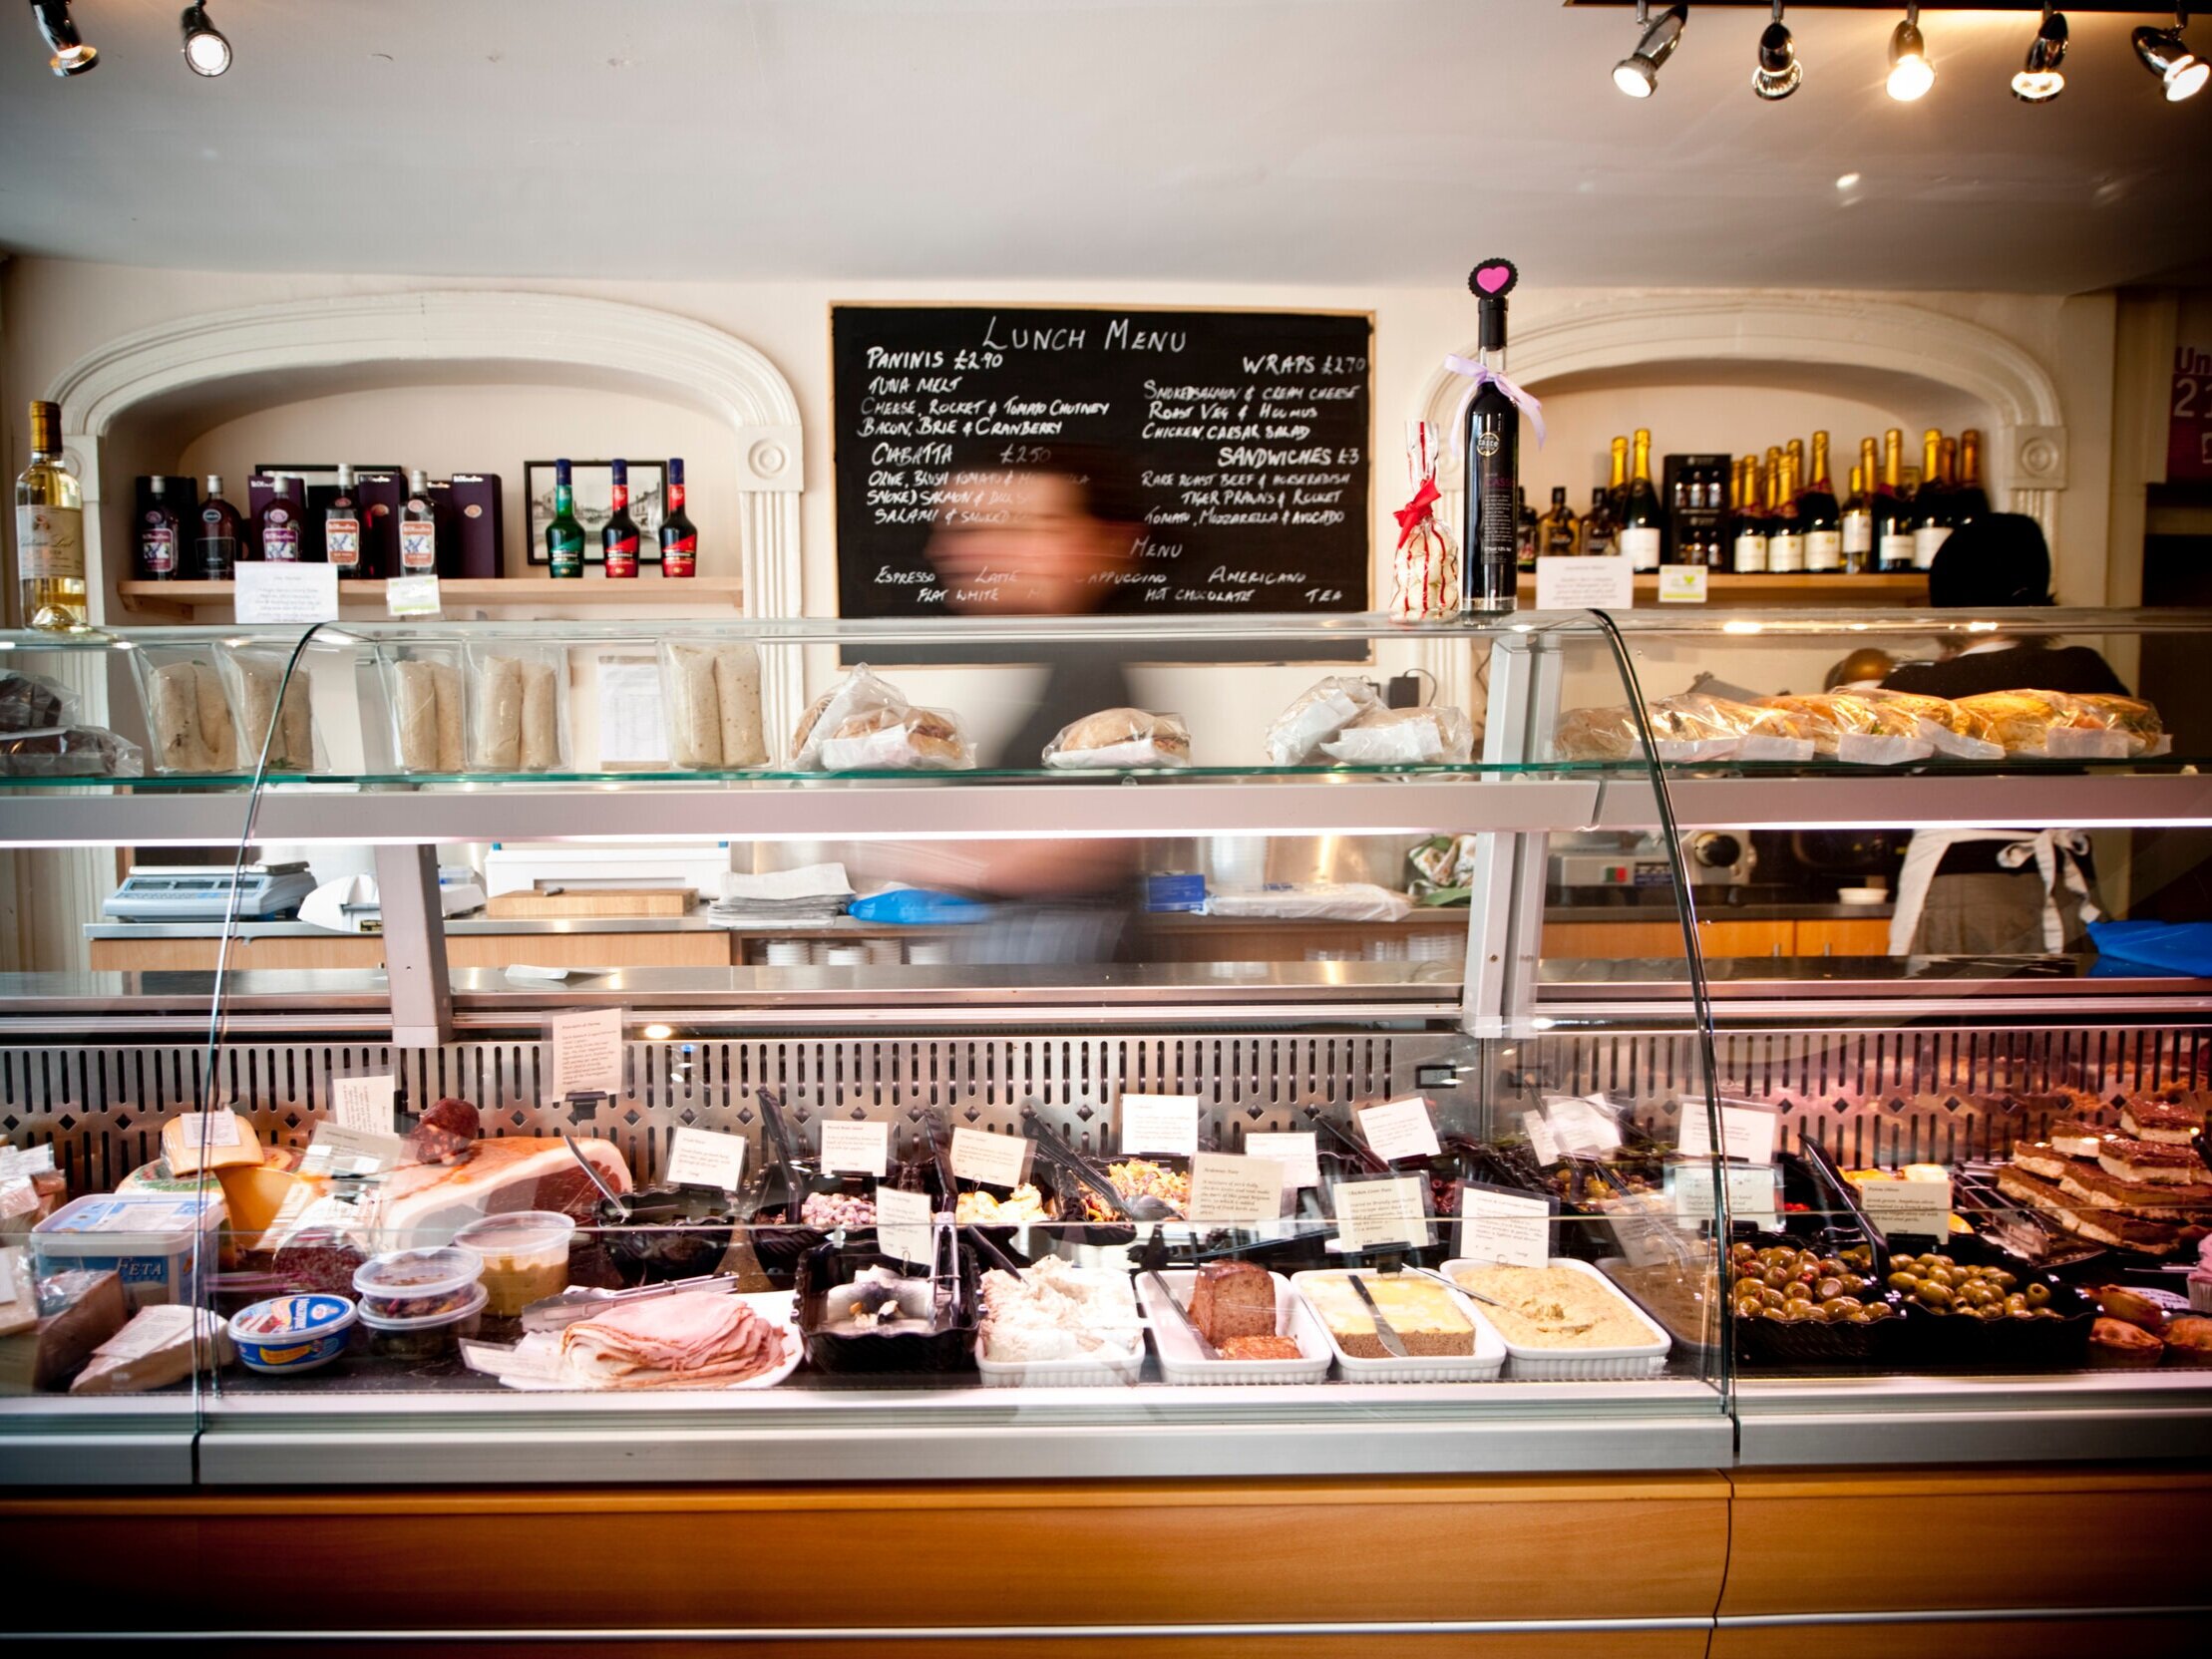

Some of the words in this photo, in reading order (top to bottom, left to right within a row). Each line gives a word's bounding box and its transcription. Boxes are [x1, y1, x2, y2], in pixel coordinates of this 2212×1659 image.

[982, 315, 1086, 351] LUNCH
[1104, 318, 1186, 353] MENU
[866, 345, 944, 370] PANINIS
[1243, 353, 1315, 376] WRAPS
[869, 375, 912, 396] TUNA
[916, 375, 963, 394] MELT
[928, 398, 987, 416] ROCKET
[1002, 395, 1048, 417] TOMATO
[1049, 399, 1110, 417] CHUTNEY
[1148, 400, 1195, 421] ROAST
[1201, 402, 1230, 420] VEG
[916, 416, 958, 436] BRIE
[975, 416, 1063, 437] CRANBERRY
[1265, 425, 1311, 441] SALAD
[871, 441, 953, 468] CIABATTA
[1217, 445, 1333, 469] SANDWICHES
[913, 470, 949, 487] BLUSH
[1141, 470, 1176, 488] RARE
[1178, 474, 1219, 487] ROAST
[1221, 473, 1257, 487] BEEF
[920, 490, 972, 506] SALMON
[1180, 490, 1221, 506] TIGER
[1222, 490, 1278, 505] PRAWNS
[874, 507, 940, 525] SALAMI
[1291, 509, 1346, 526] AVOCADO
[1129, 534, 1185, 559] MENU
[874, 564, 936, 584] ESPRESSO
[974, 565, 1021, 584] LATTE
[1207, 564, 1307, 585] AMERICANO
[917, 587, 948, 603] FLAT
[955, 589, 1000, 602] WHITE
[1144, 586, 1172, 603] HOT
[1174, 587, 1257, 603] CHOCOLATE
[1304, 586, 1344, 604] TEA
[116, 1255, 164, 1277] FETA
